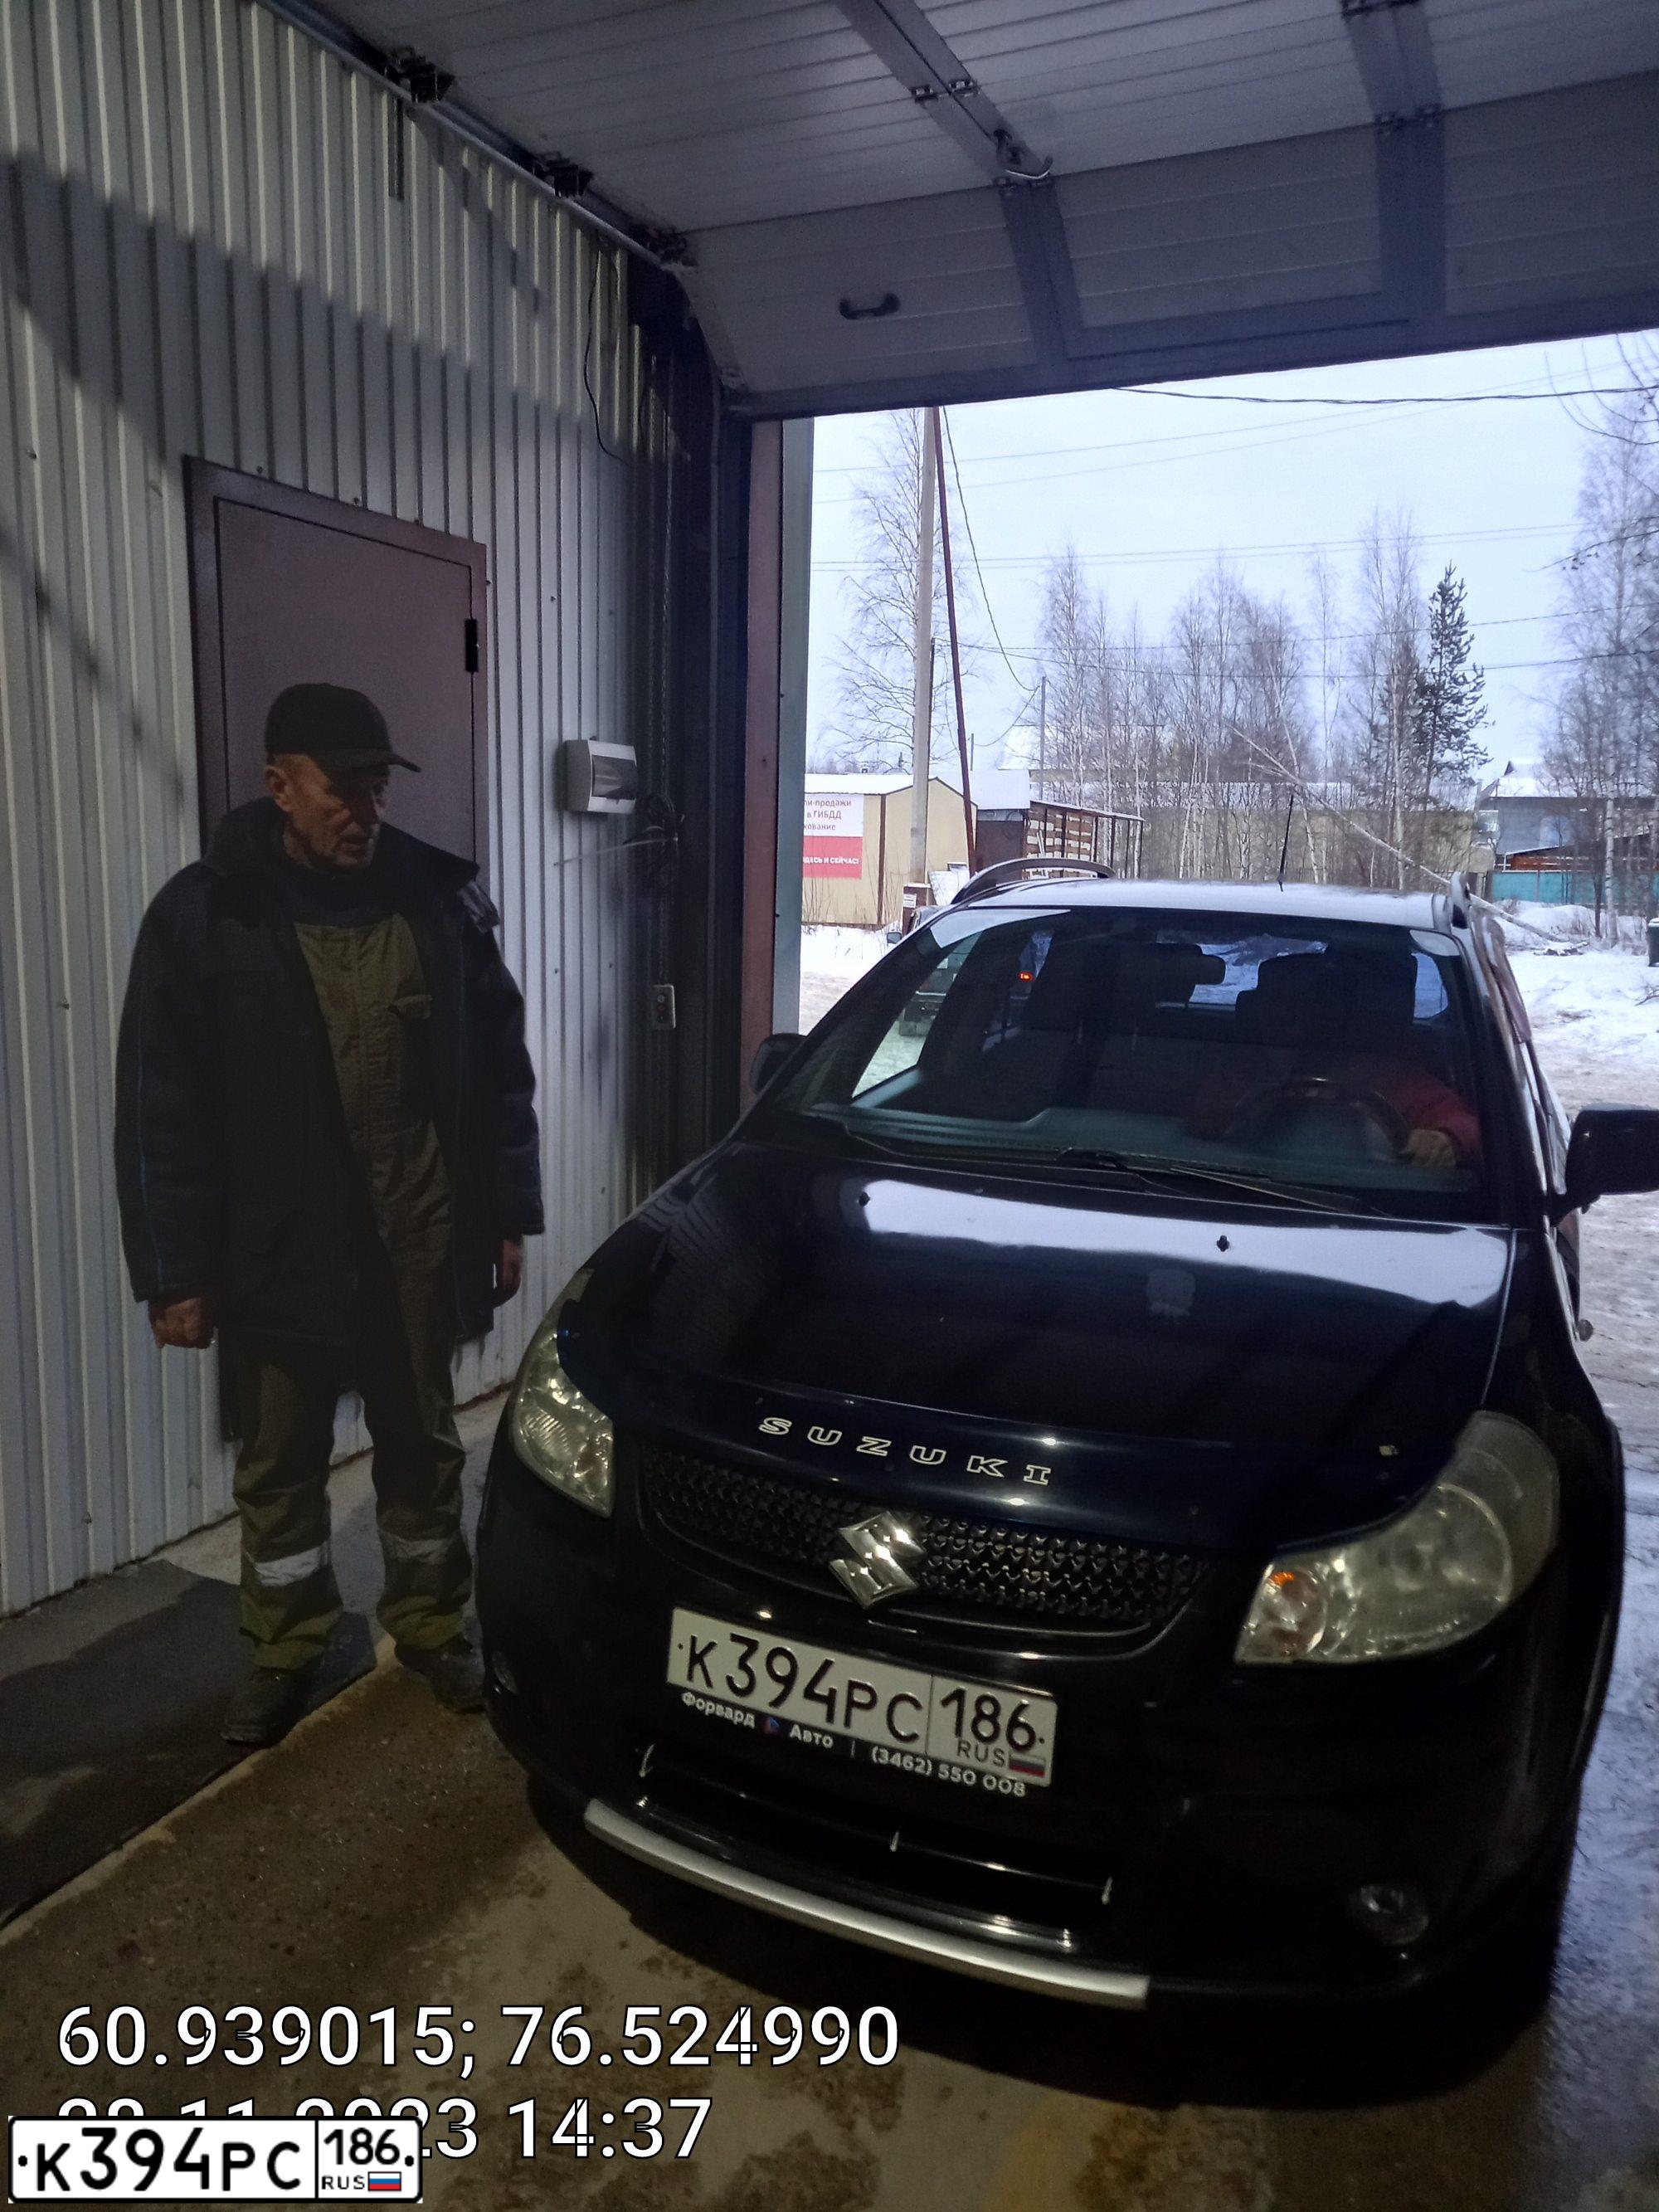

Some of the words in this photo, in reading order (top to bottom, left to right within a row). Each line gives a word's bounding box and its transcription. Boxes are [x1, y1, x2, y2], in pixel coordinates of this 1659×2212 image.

[814, 810, 842, 820] ГИБДД
[759, 1417, 1051, 1485] SUZUKI
[682, 1691, 756, 1729] Форвард
[789, 1723, 834, 1750] Авто
[871, 1745, 933, 1776] (3462)
[938, 1764, 976, 1786] 550
[983, 1775, 1027, 1798] 008
[941, 1686, 1037, 1752] 186
[956, 1739, 1006, 1766] RUS
